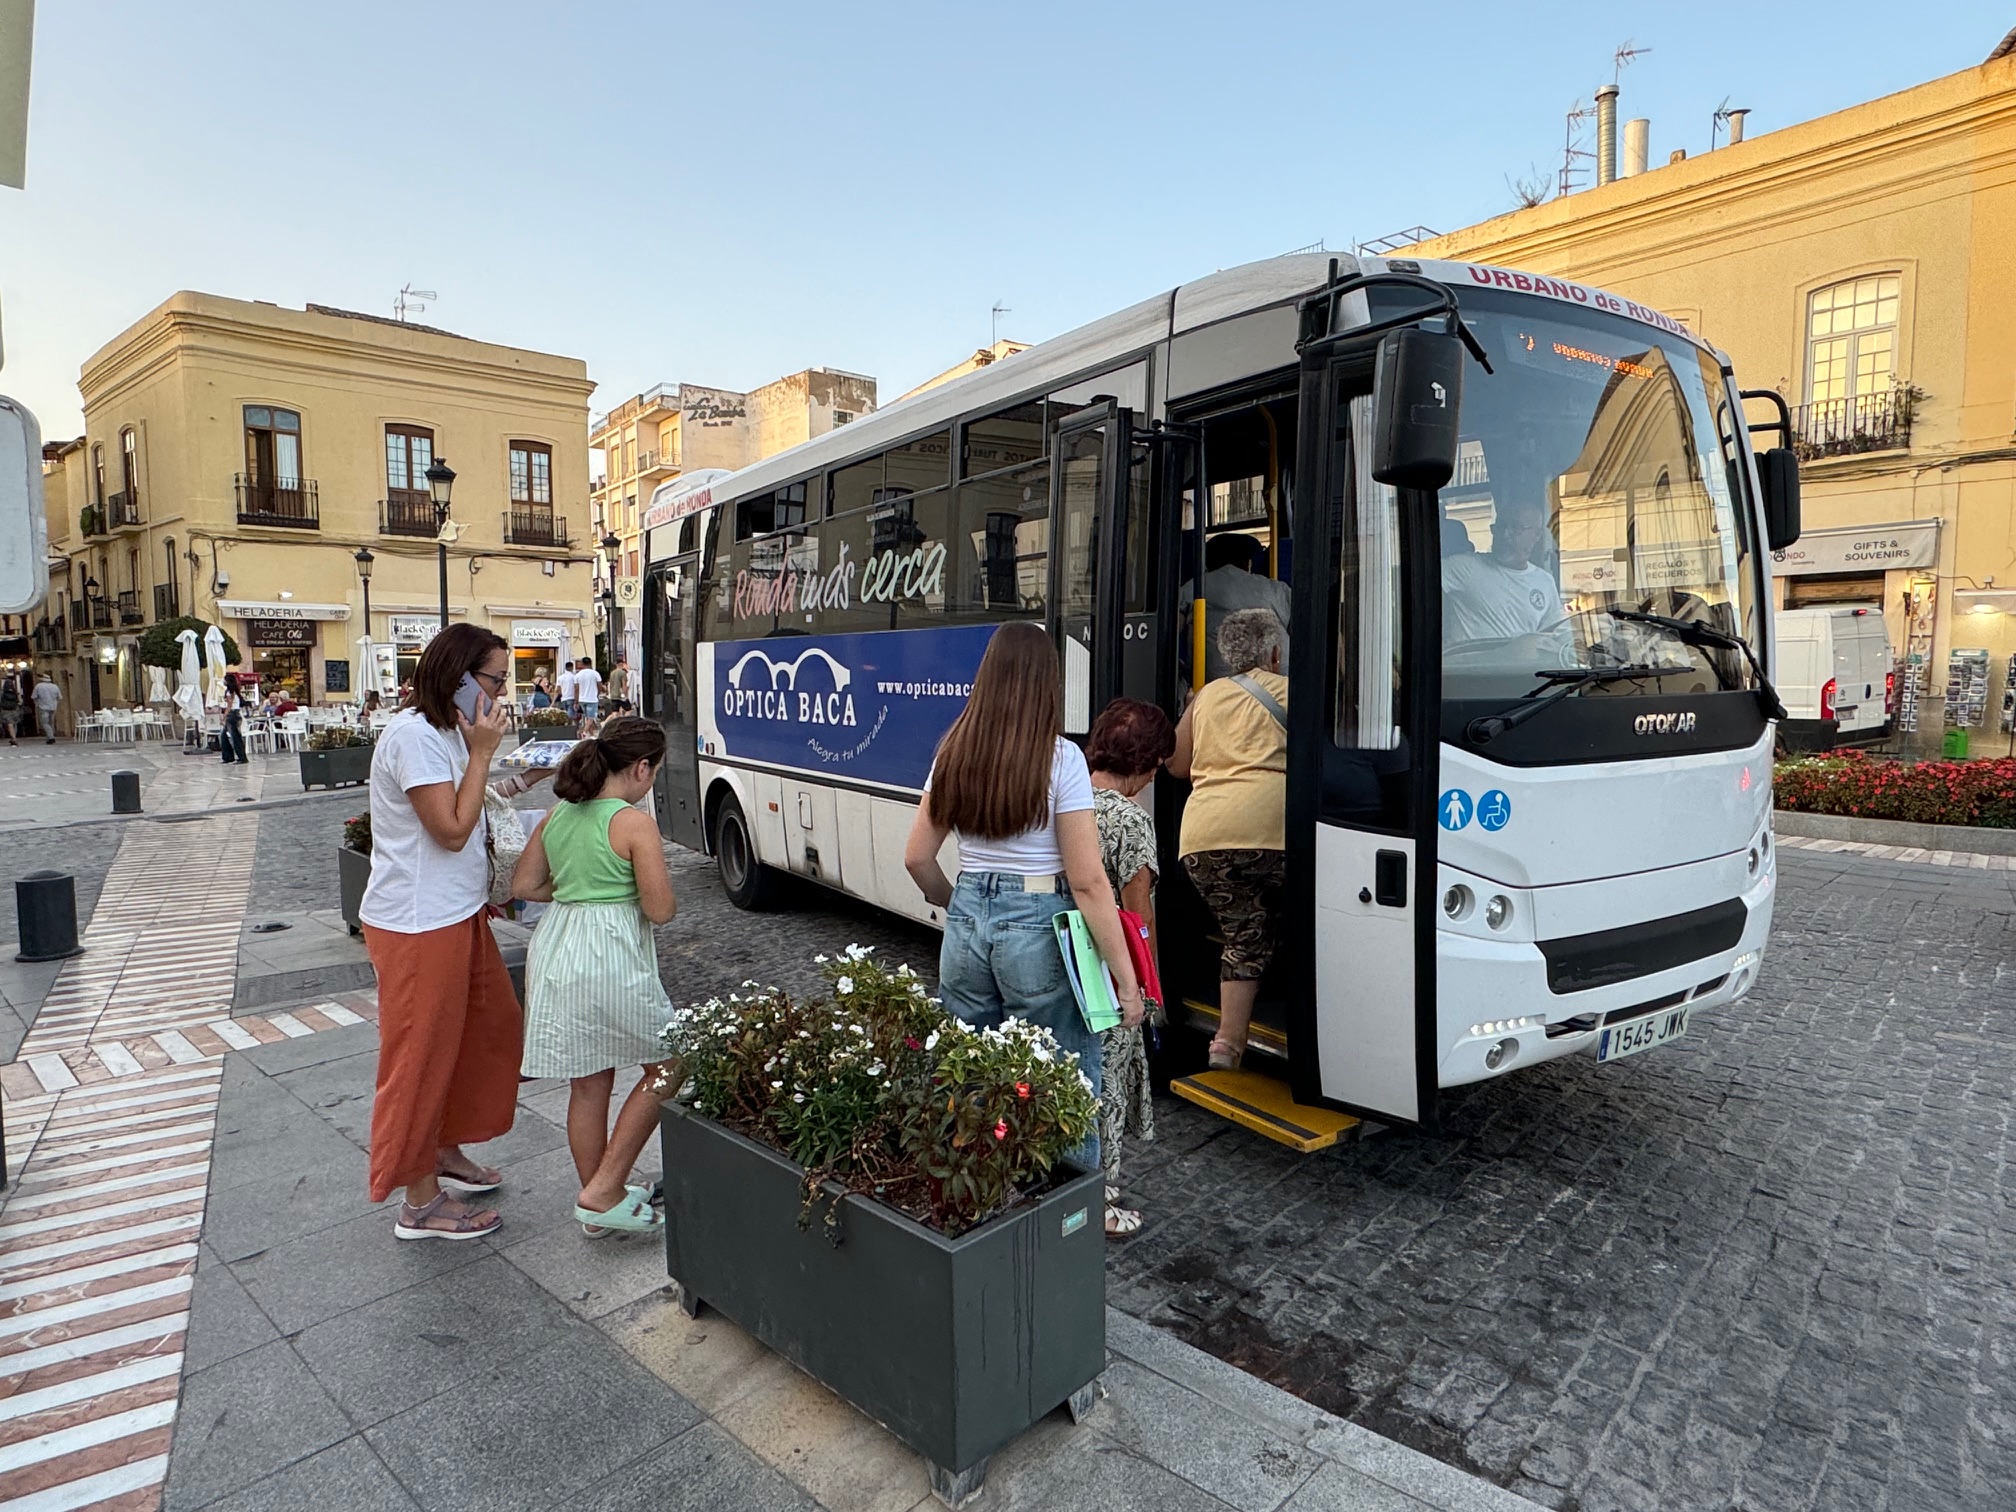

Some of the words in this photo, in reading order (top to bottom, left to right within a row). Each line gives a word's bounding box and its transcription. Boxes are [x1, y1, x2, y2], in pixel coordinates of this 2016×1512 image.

[1468, 267, 1588, 302] URBANO
[1594, 292, 1620, 311] de
[1625, 300, 1690, 337] RONDA
[677, 500, 686, 515] de
[687, 488, 712, 511] RONDA
[1845, 549, 1910, 561] SOUVENIRS
[1854, 541, 1887, 550] GIFTS
[1646, 560, 1688, 570] REGALOS
[1646, 568, 1702, 579] RECUERDOS
[733, 549, 798, 620] Ronda
[860, 543, 947, 603] cerca
[234, 607, 303, 617] HELADERIA
[254, 621, 309, 629] HELADERIA
[724, 689, 788, 721] OPTICA
[798, 692, 857, 726] BACA
[807, 738, 839, 762] Alegra
[842, 750, 854, 761] tu
[857, 705, 888, 755] mirada
[1634, 712, 1696, 735] OTOKAR
[1614, 1021, 1654, 1054] 1545
